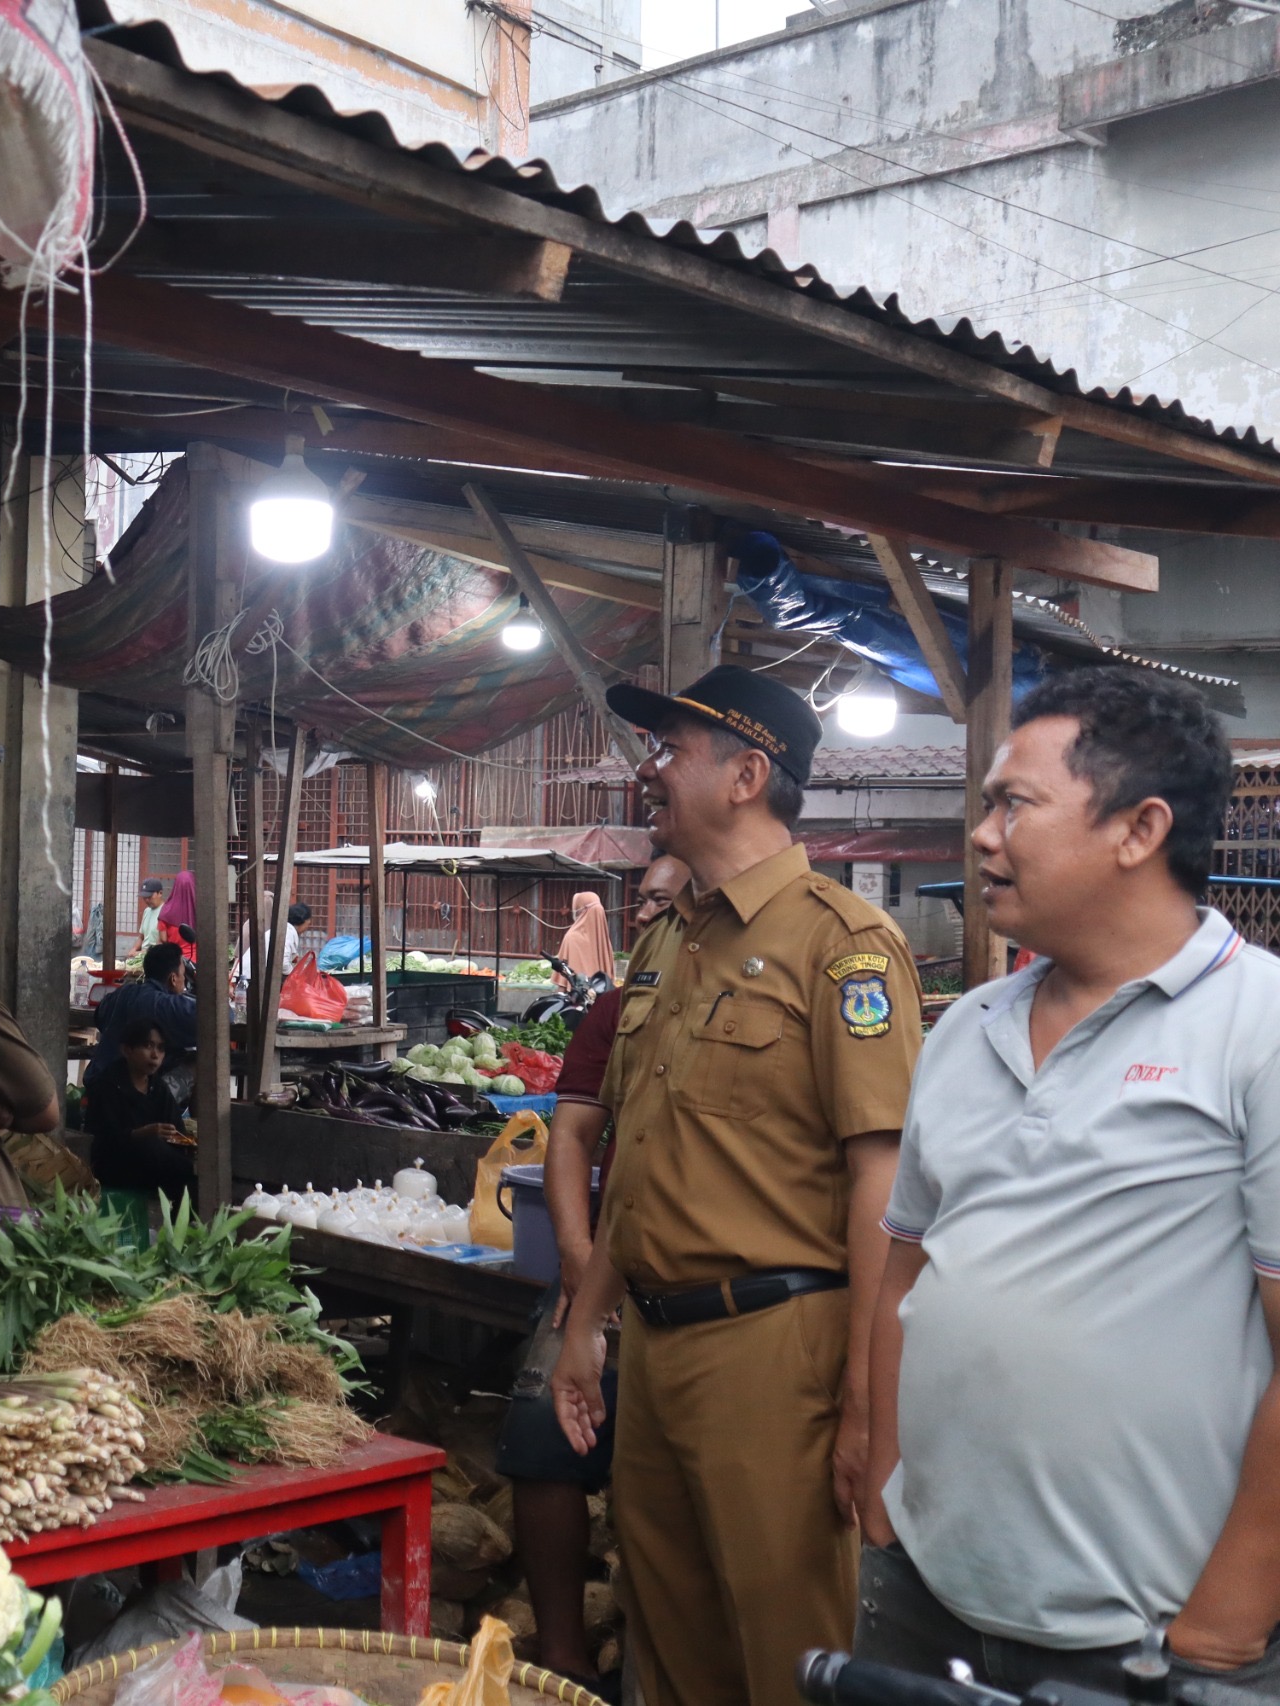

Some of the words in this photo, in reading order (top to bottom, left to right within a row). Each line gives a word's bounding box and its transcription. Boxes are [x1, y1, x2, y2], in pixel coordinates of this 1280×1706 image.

[829, 954, 866, 972] PEMERINTAH
[867, 955, 885, 965] KOTA
[834, 964, 858, 977] TEBING
[861, 962, 885, 971] TINGGI
